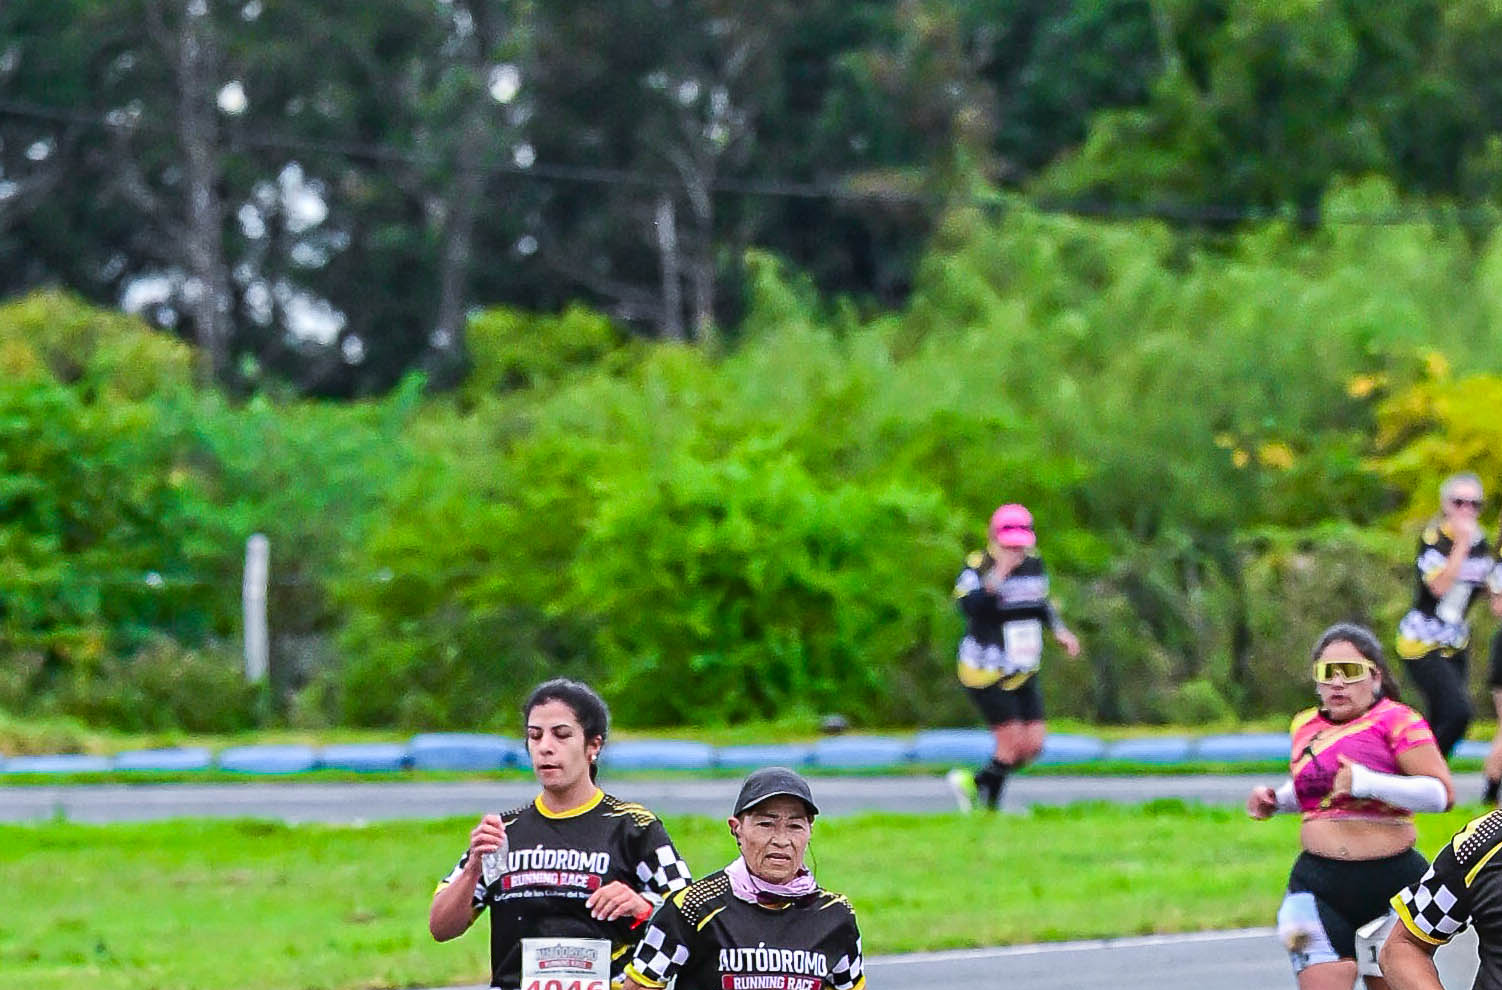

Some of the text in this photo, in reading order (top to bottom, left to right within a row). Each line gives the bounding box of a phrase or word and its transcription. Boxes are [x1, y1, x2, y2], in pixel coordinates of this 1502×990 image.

[508, 844, 610, 874] UTÓDROMO
[718, 941, 828, 977] AUTÓDROMO
[733, 976, 785, 990] RUNNING
